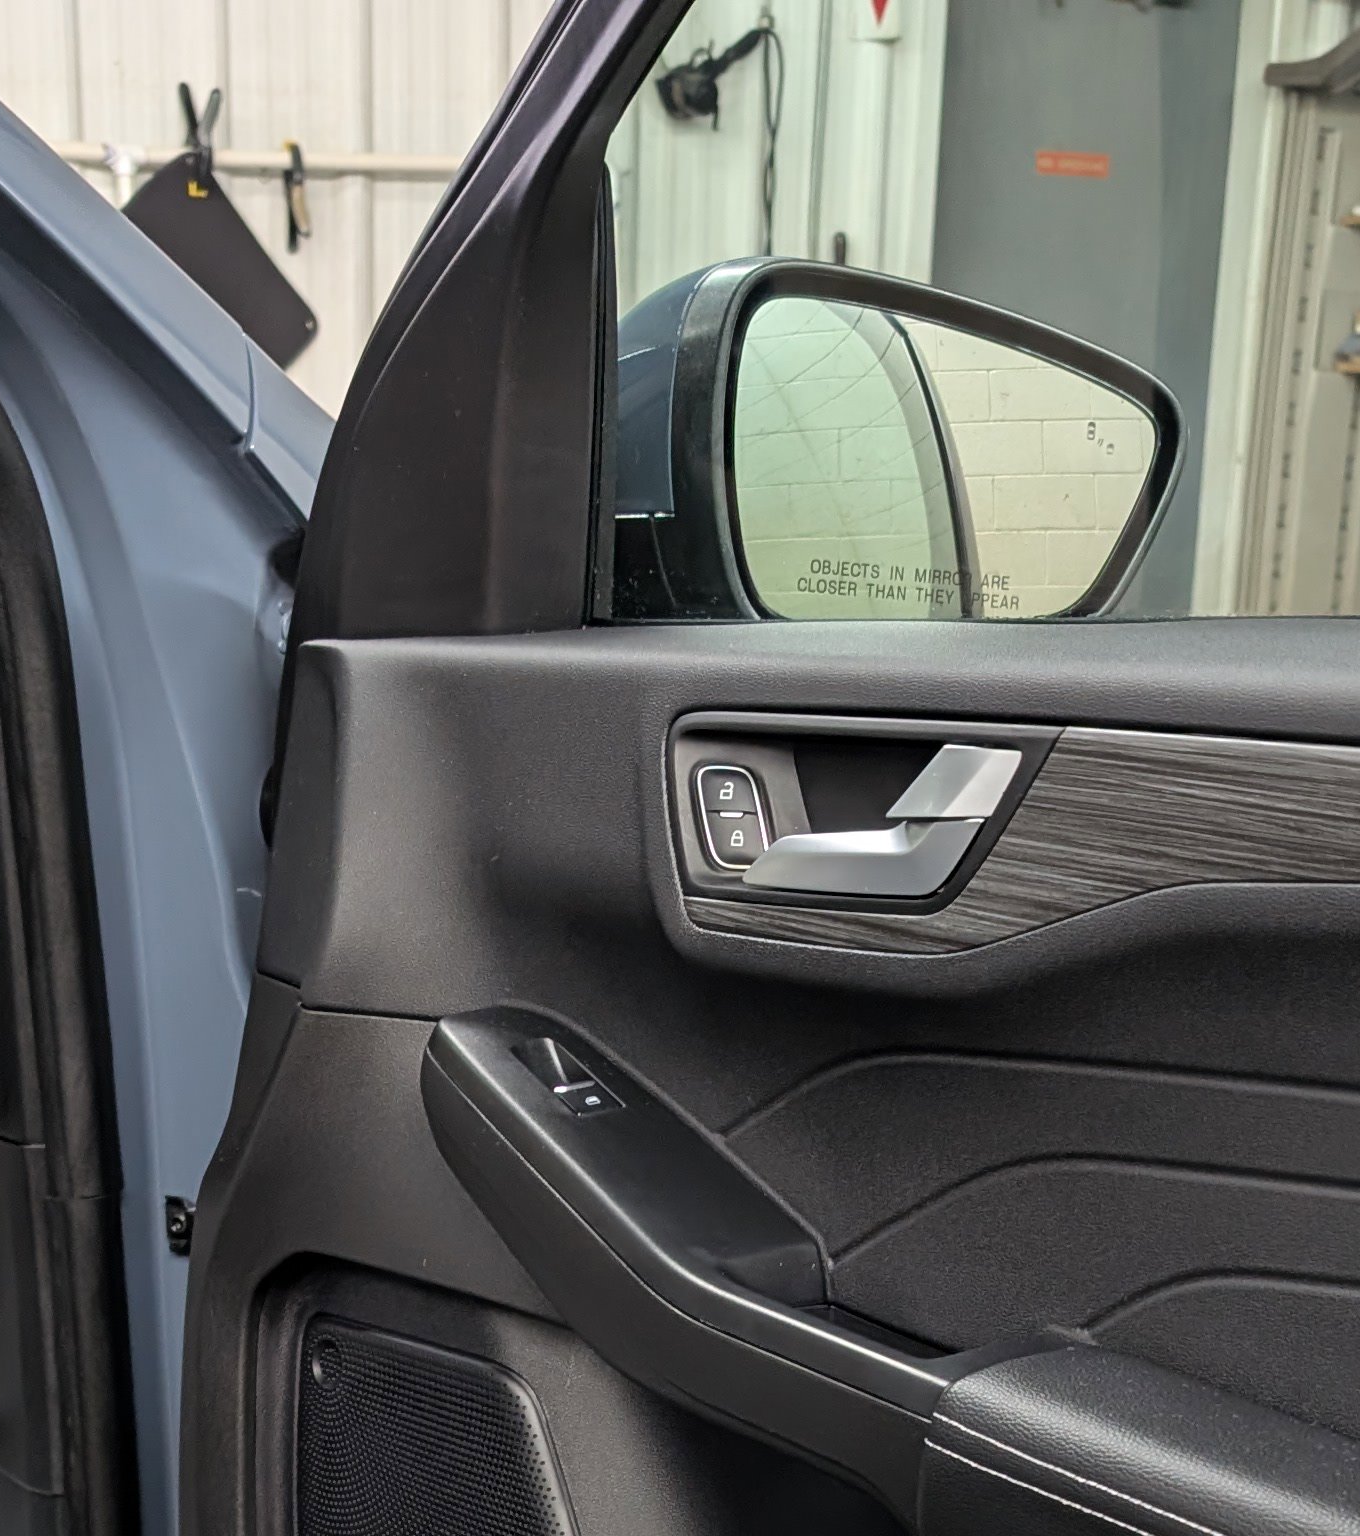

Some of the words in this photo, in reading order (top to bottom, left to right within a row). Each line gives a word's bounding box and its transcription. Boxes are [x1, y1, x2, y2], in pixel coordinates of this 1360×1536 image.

[810, 558, 880, 579] OBJECTS
[890, 566, 904, 581] IN
[981, 574, 1011, 591] ARE
[797, 577, 857, 597] CLOSER
[867, 583, 906, 601] THAN
[916, 587, 955, 605] THEY
[961, 591, 1020, 610] PPEAR
